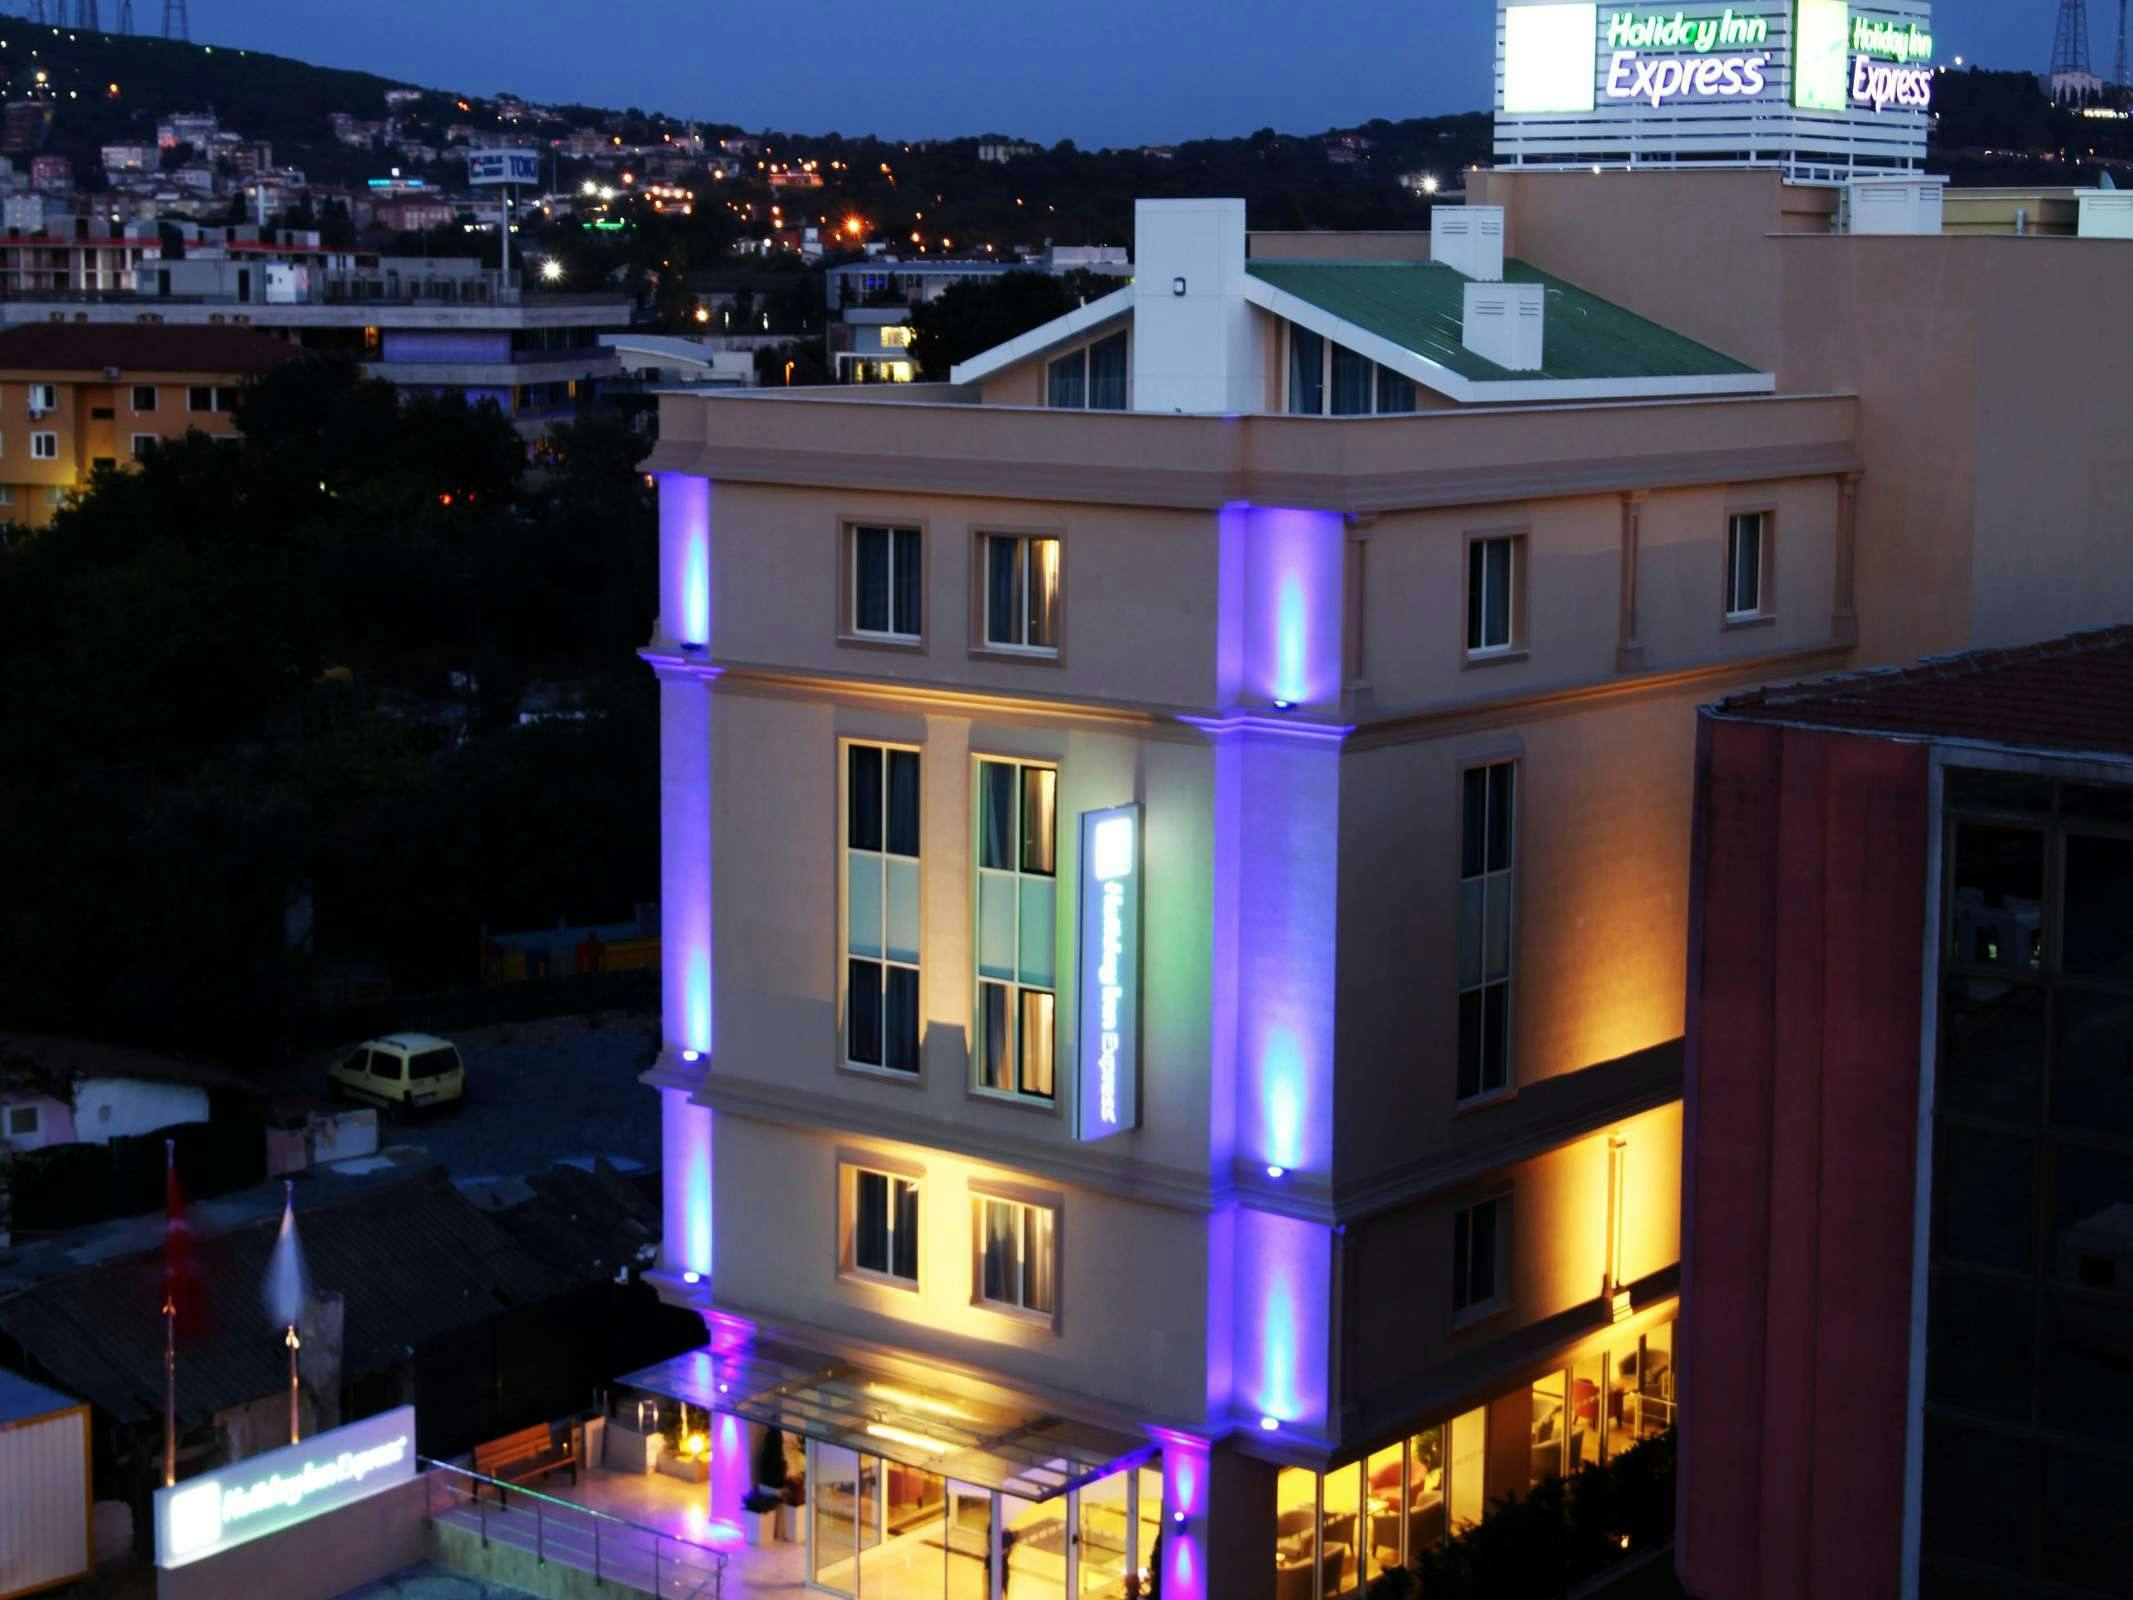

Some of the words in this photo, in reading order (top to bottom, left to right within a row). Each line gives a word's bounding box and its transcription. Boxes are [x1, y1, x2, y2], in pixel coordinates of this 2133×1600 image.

[1607, 12, 1718, 52] Holiday
[1720, 9, 1768, 44] Inn
[1853, 16, 1908, 63] Holiday
[1908, 23, 1932, 58] Inn
[1606, 50, 1767, 109] Express
[1852, 54, 1931, 114] Express
